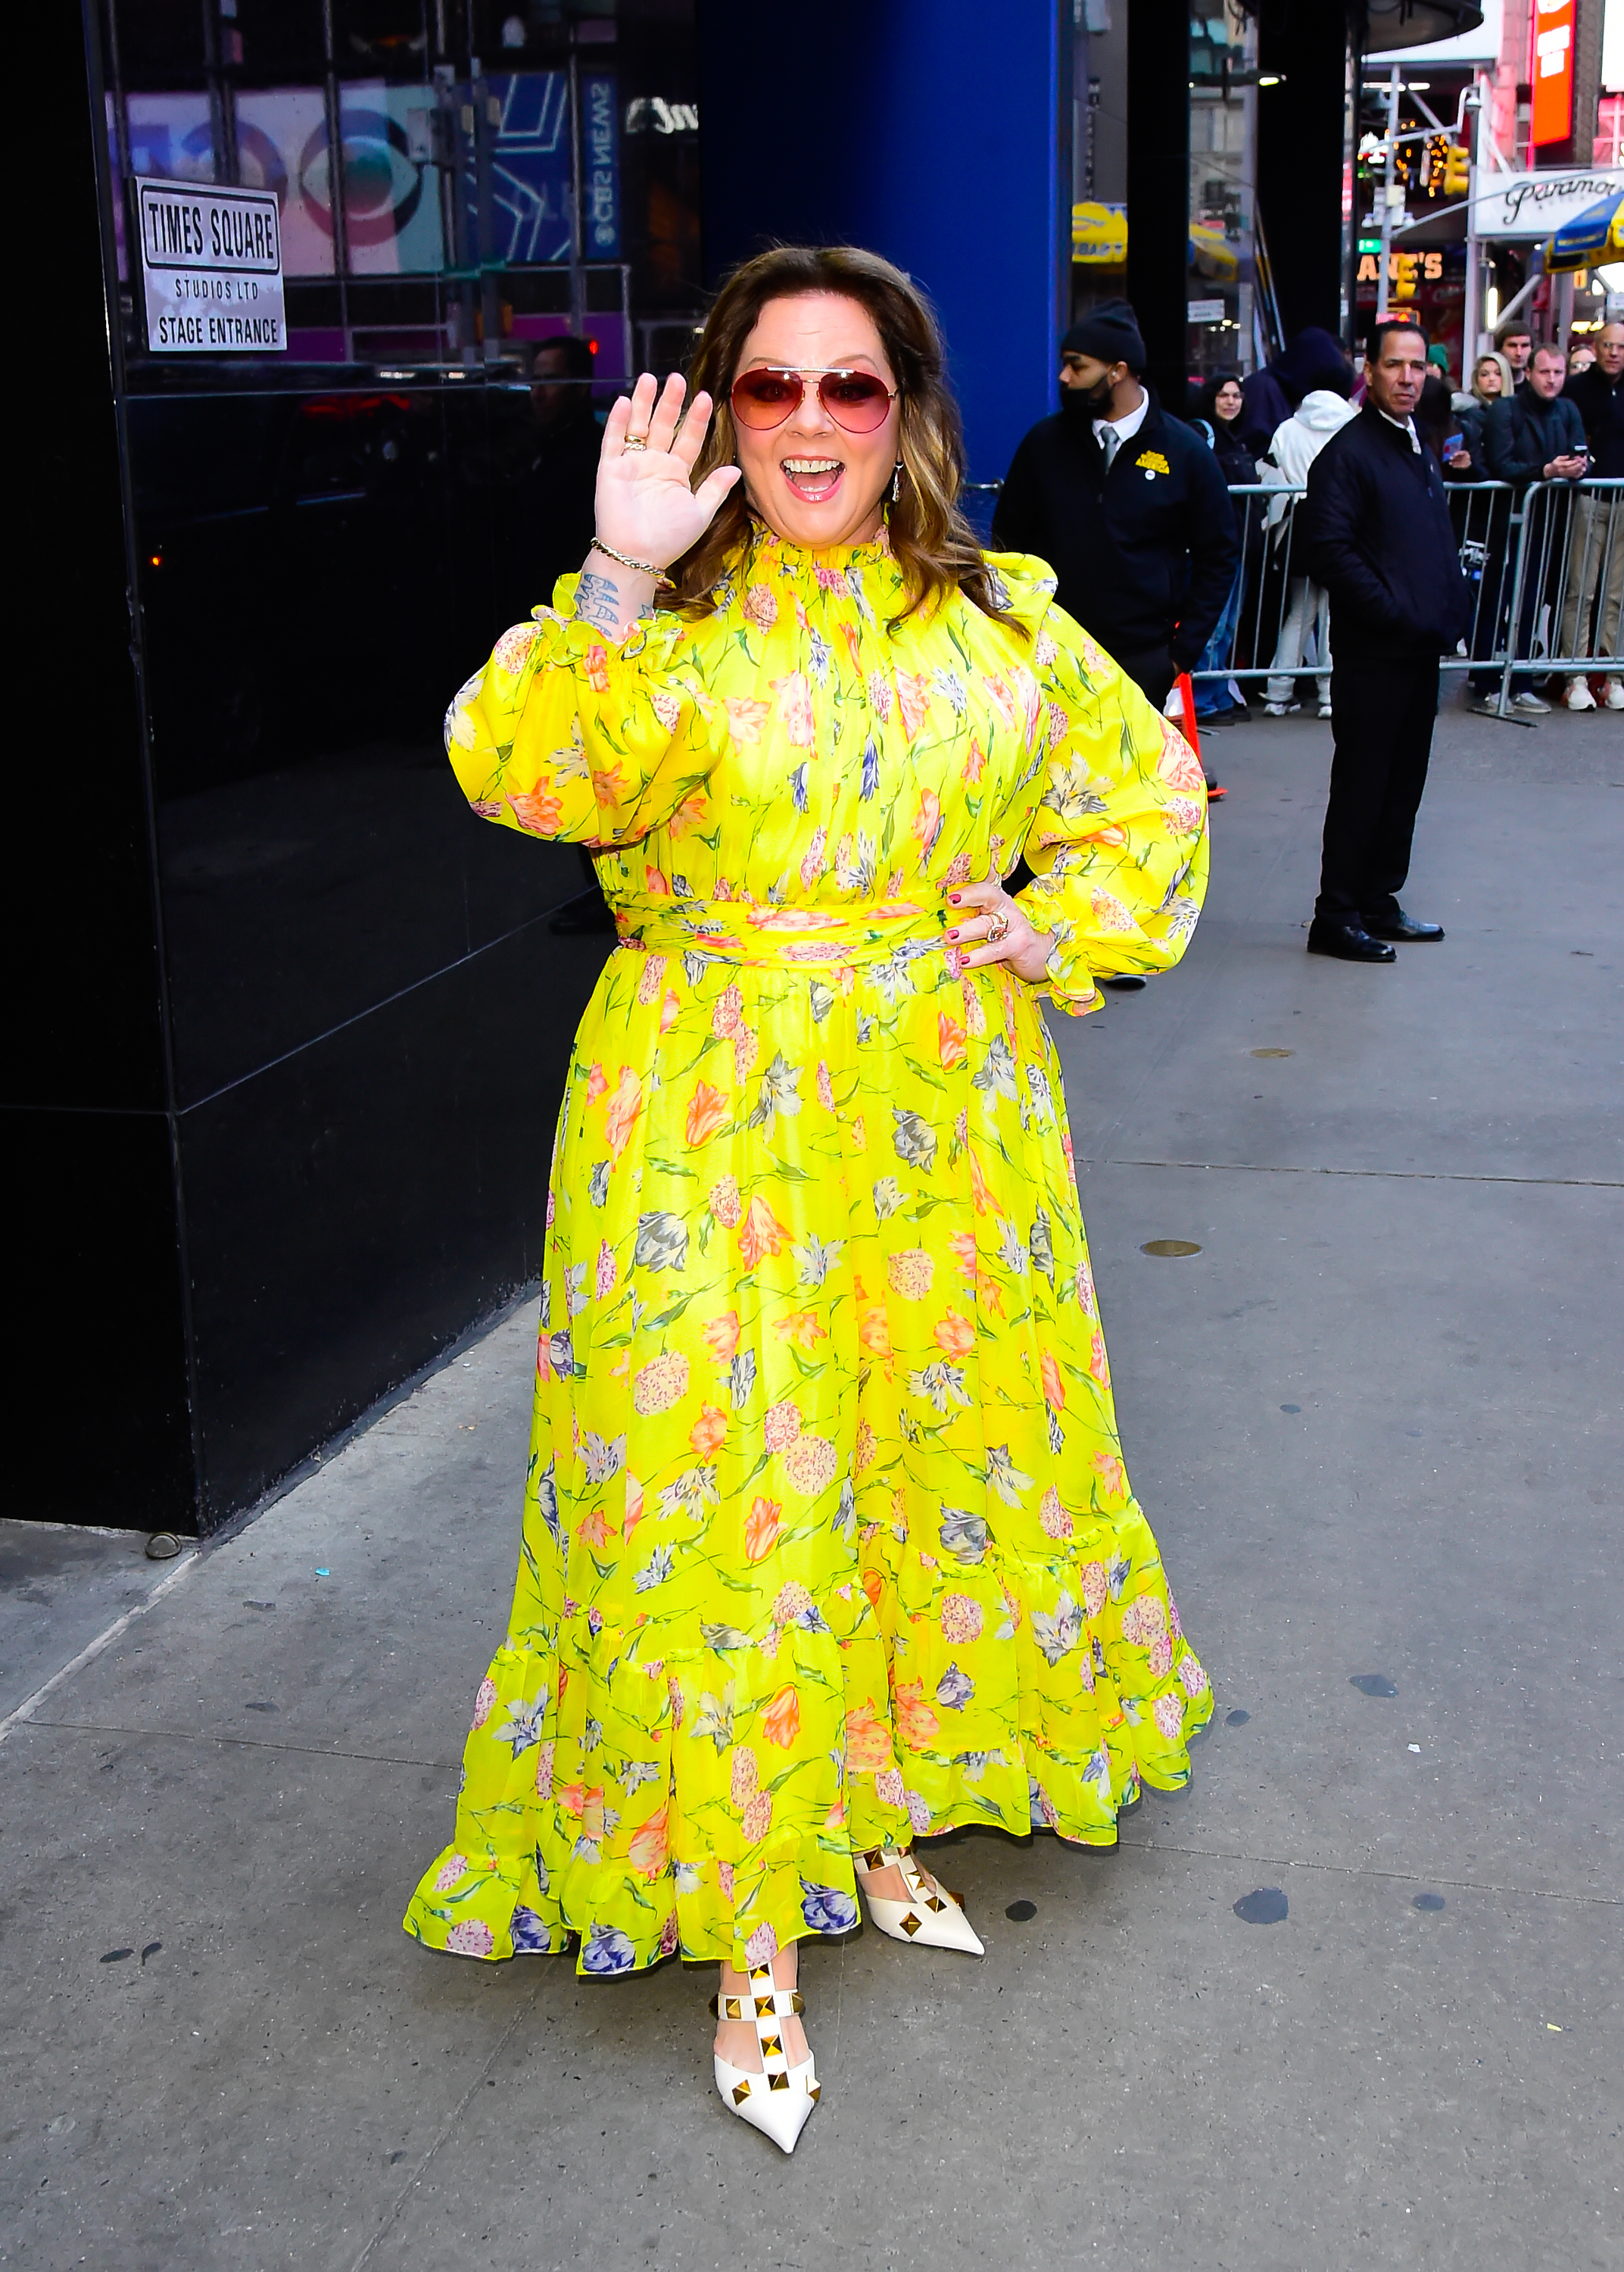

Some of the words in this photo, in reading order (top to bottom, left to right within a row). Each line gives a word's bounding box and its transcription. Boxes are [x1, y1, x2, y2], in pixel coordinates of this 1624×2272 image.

[148, 203, 203, 255] TIMES
[210, 208, 274, 259] SQUARE
[175, 278, 232, 300] STUDIOS
[237, 282, 258, 300] LTD
[159, 316, 204, 344] STAGE
[209, 318, 278, 344] ENTRANCE
